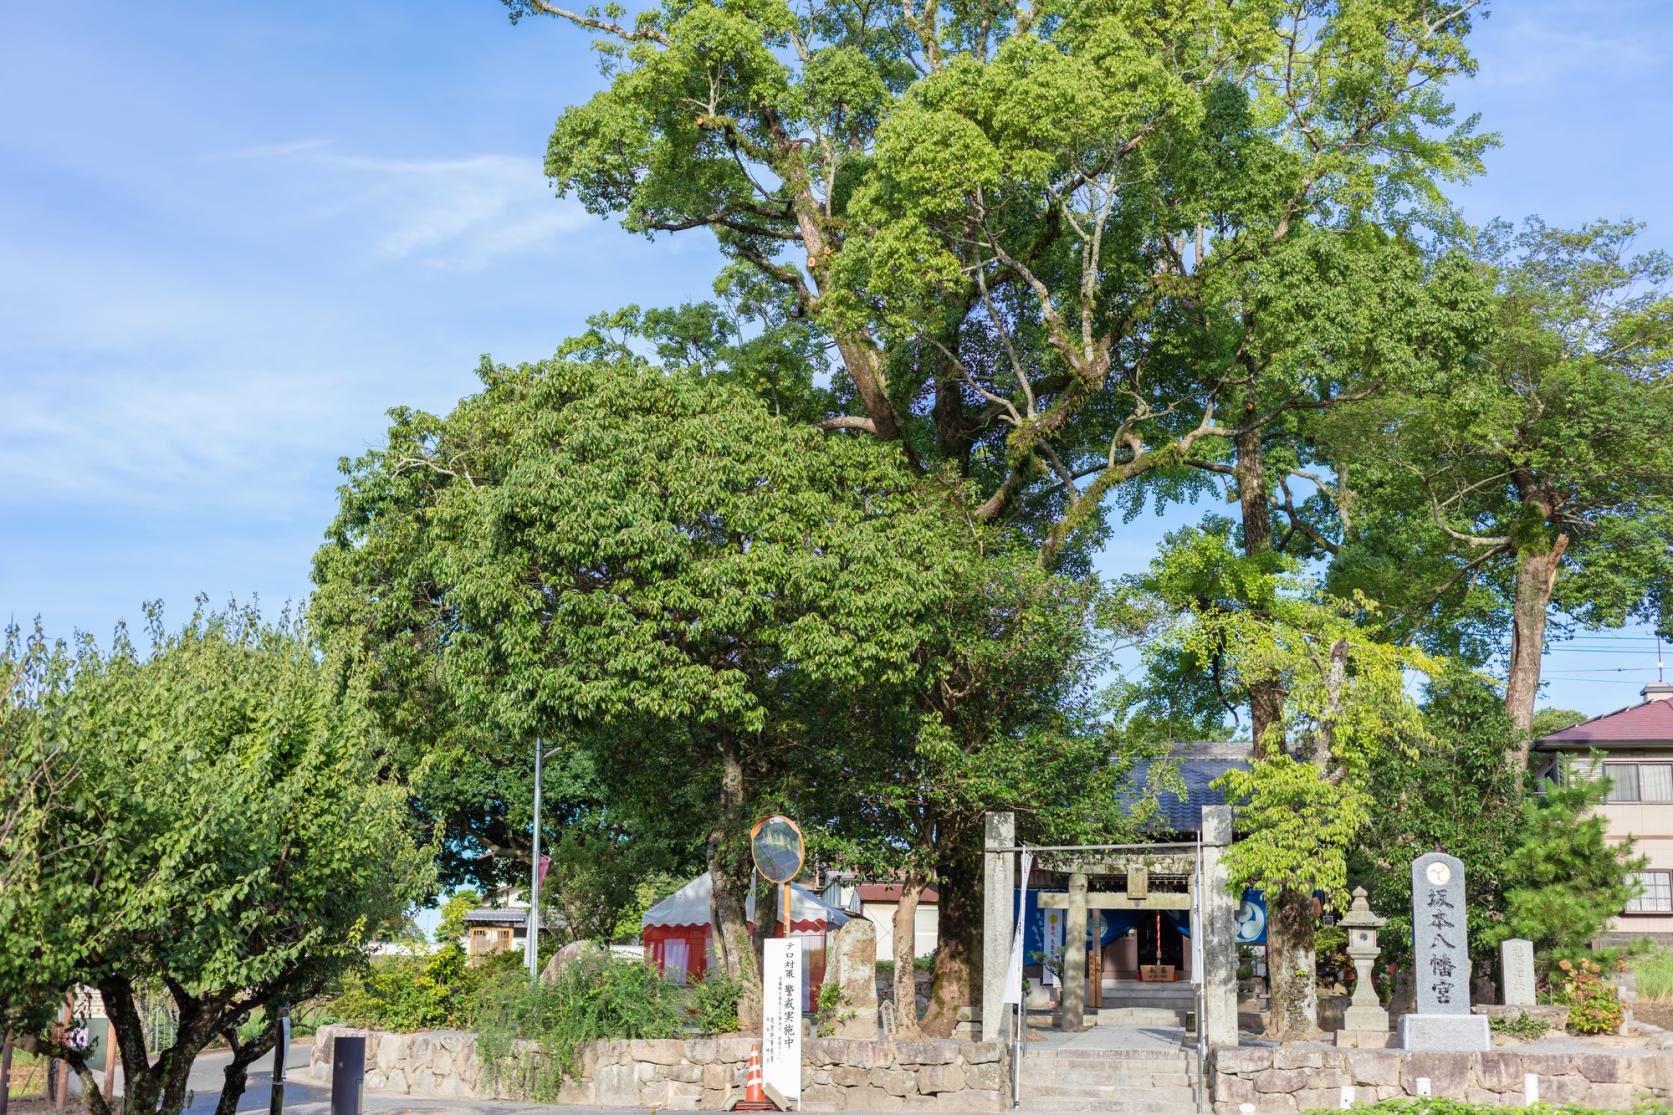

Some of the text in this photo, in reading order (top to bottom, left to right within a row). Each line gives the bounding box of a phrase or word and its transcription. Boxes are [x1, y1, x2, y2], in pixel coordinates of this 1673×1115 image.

[783, 942, 795, 1049] テロ対策 警戒実施中
[1427, 888, 1457, 1004] 坂本八幡宮
